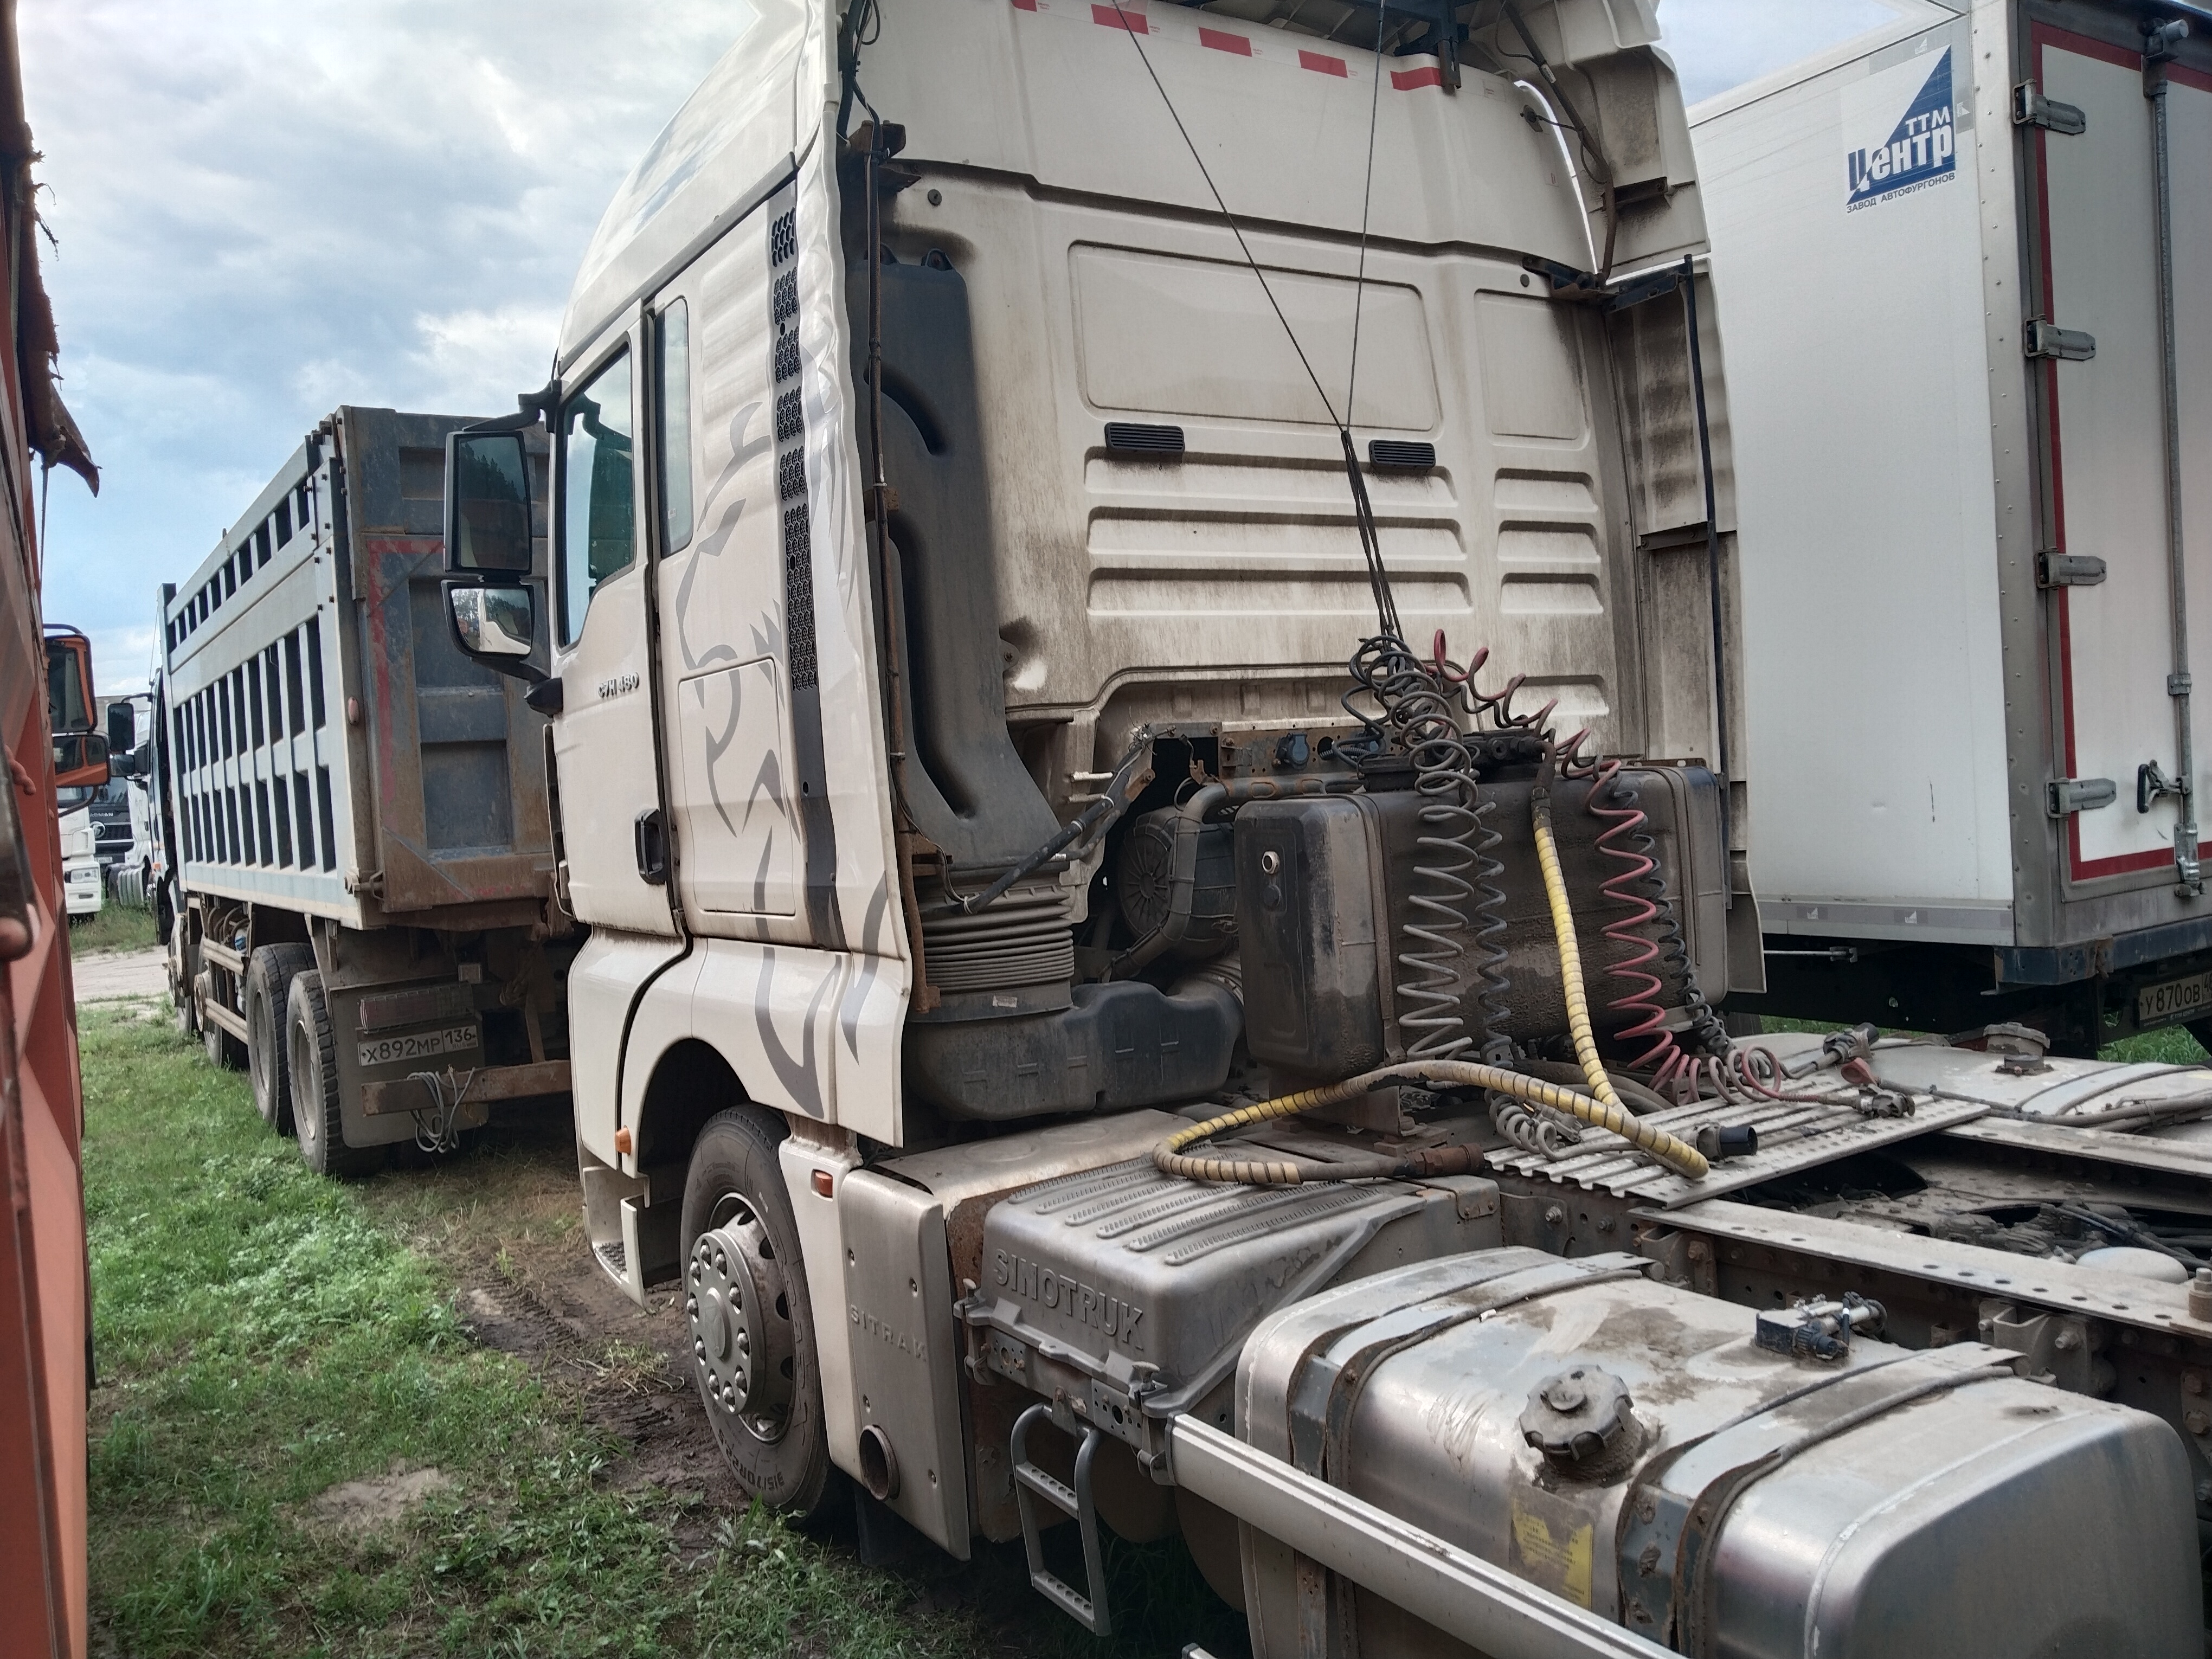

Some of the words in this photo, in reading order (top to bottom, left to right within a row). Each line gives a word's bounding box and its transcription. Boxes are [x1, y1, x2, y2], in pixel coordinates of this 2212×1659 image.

[1905, 106, 1951, 136] ТТМ
[1847, 198, 1877, 214] ЗАВОД
[1881, 172, 1956, 203] АВТОФУРГОНОВ
[618, 672, 640, 693] 480
[445, 1028, 472, 1044] 136
[993, 1248, 1144, 1352] SINOTRUK
[850, 1303, 927, 1362] SITRAK
